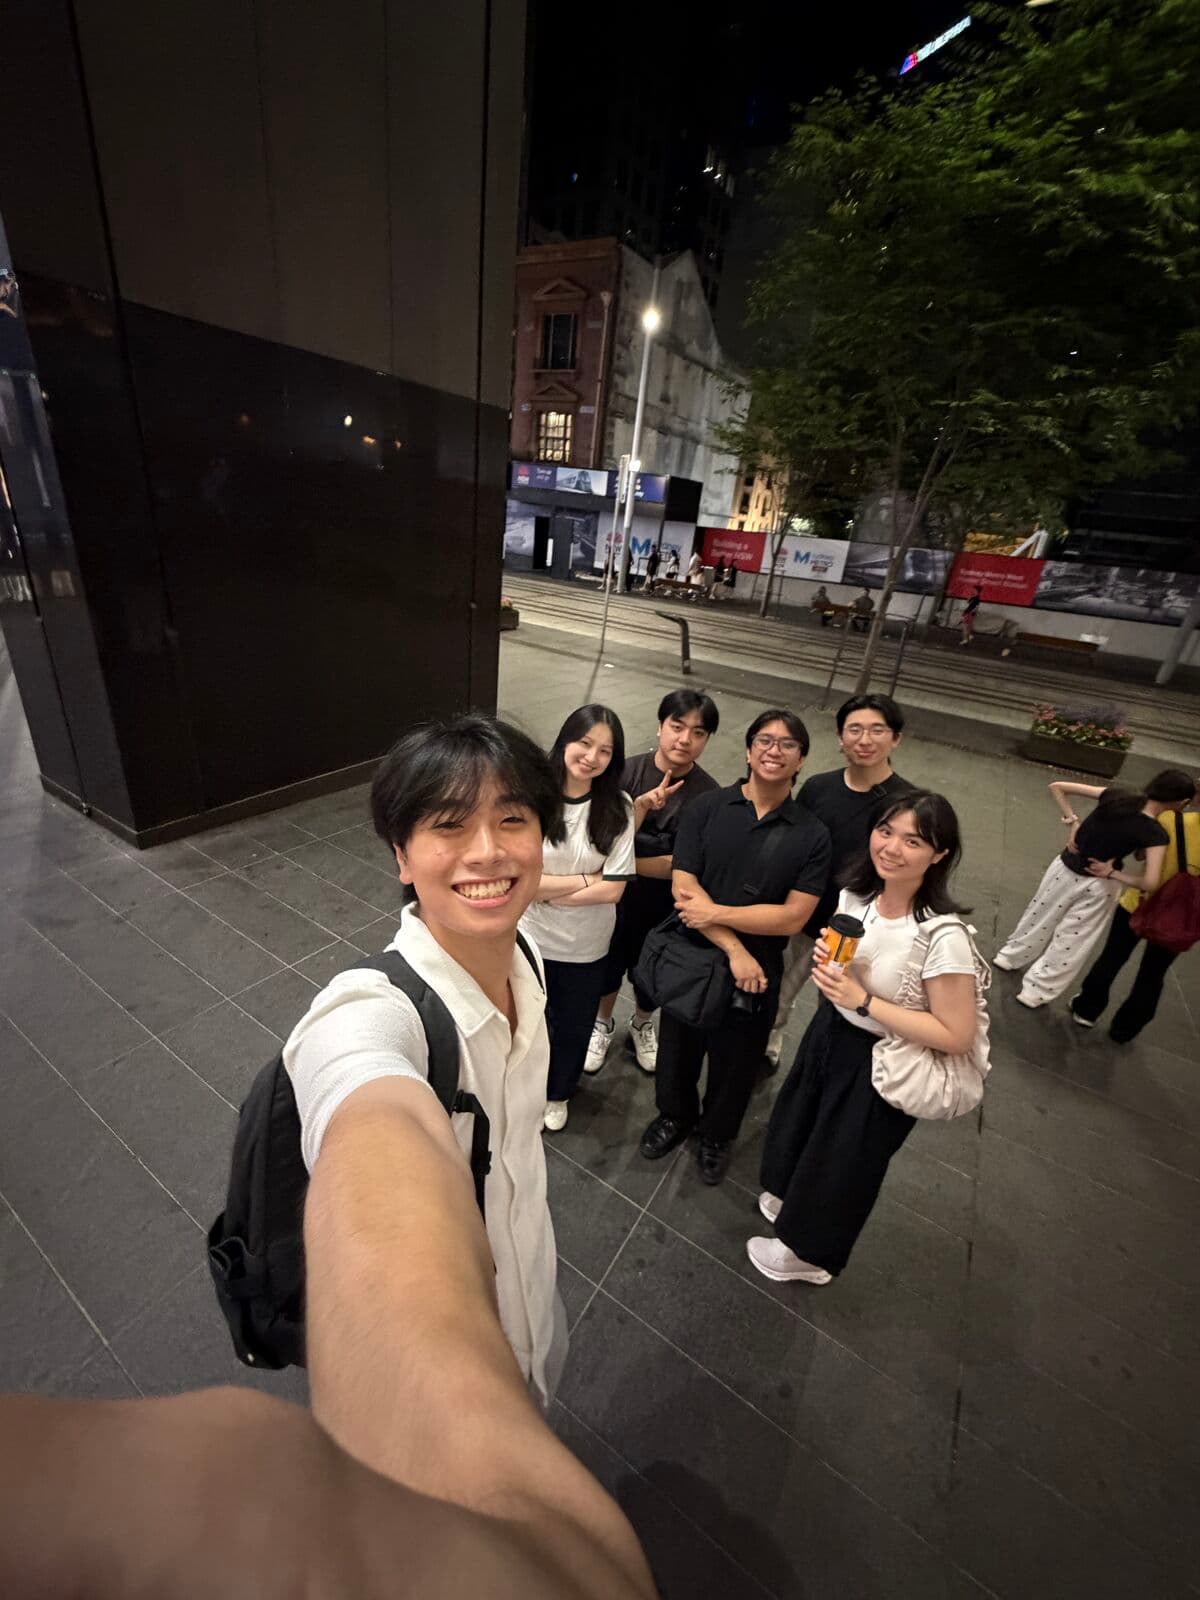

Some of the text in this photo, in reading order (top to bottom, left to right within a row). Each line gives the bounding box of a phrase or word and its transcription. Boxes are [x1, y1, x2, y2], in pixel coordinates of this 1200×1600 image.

[631, 536, 652, 556] M
[733, 552, 754, 560] NSW
[794, 550, 811, 564] M
